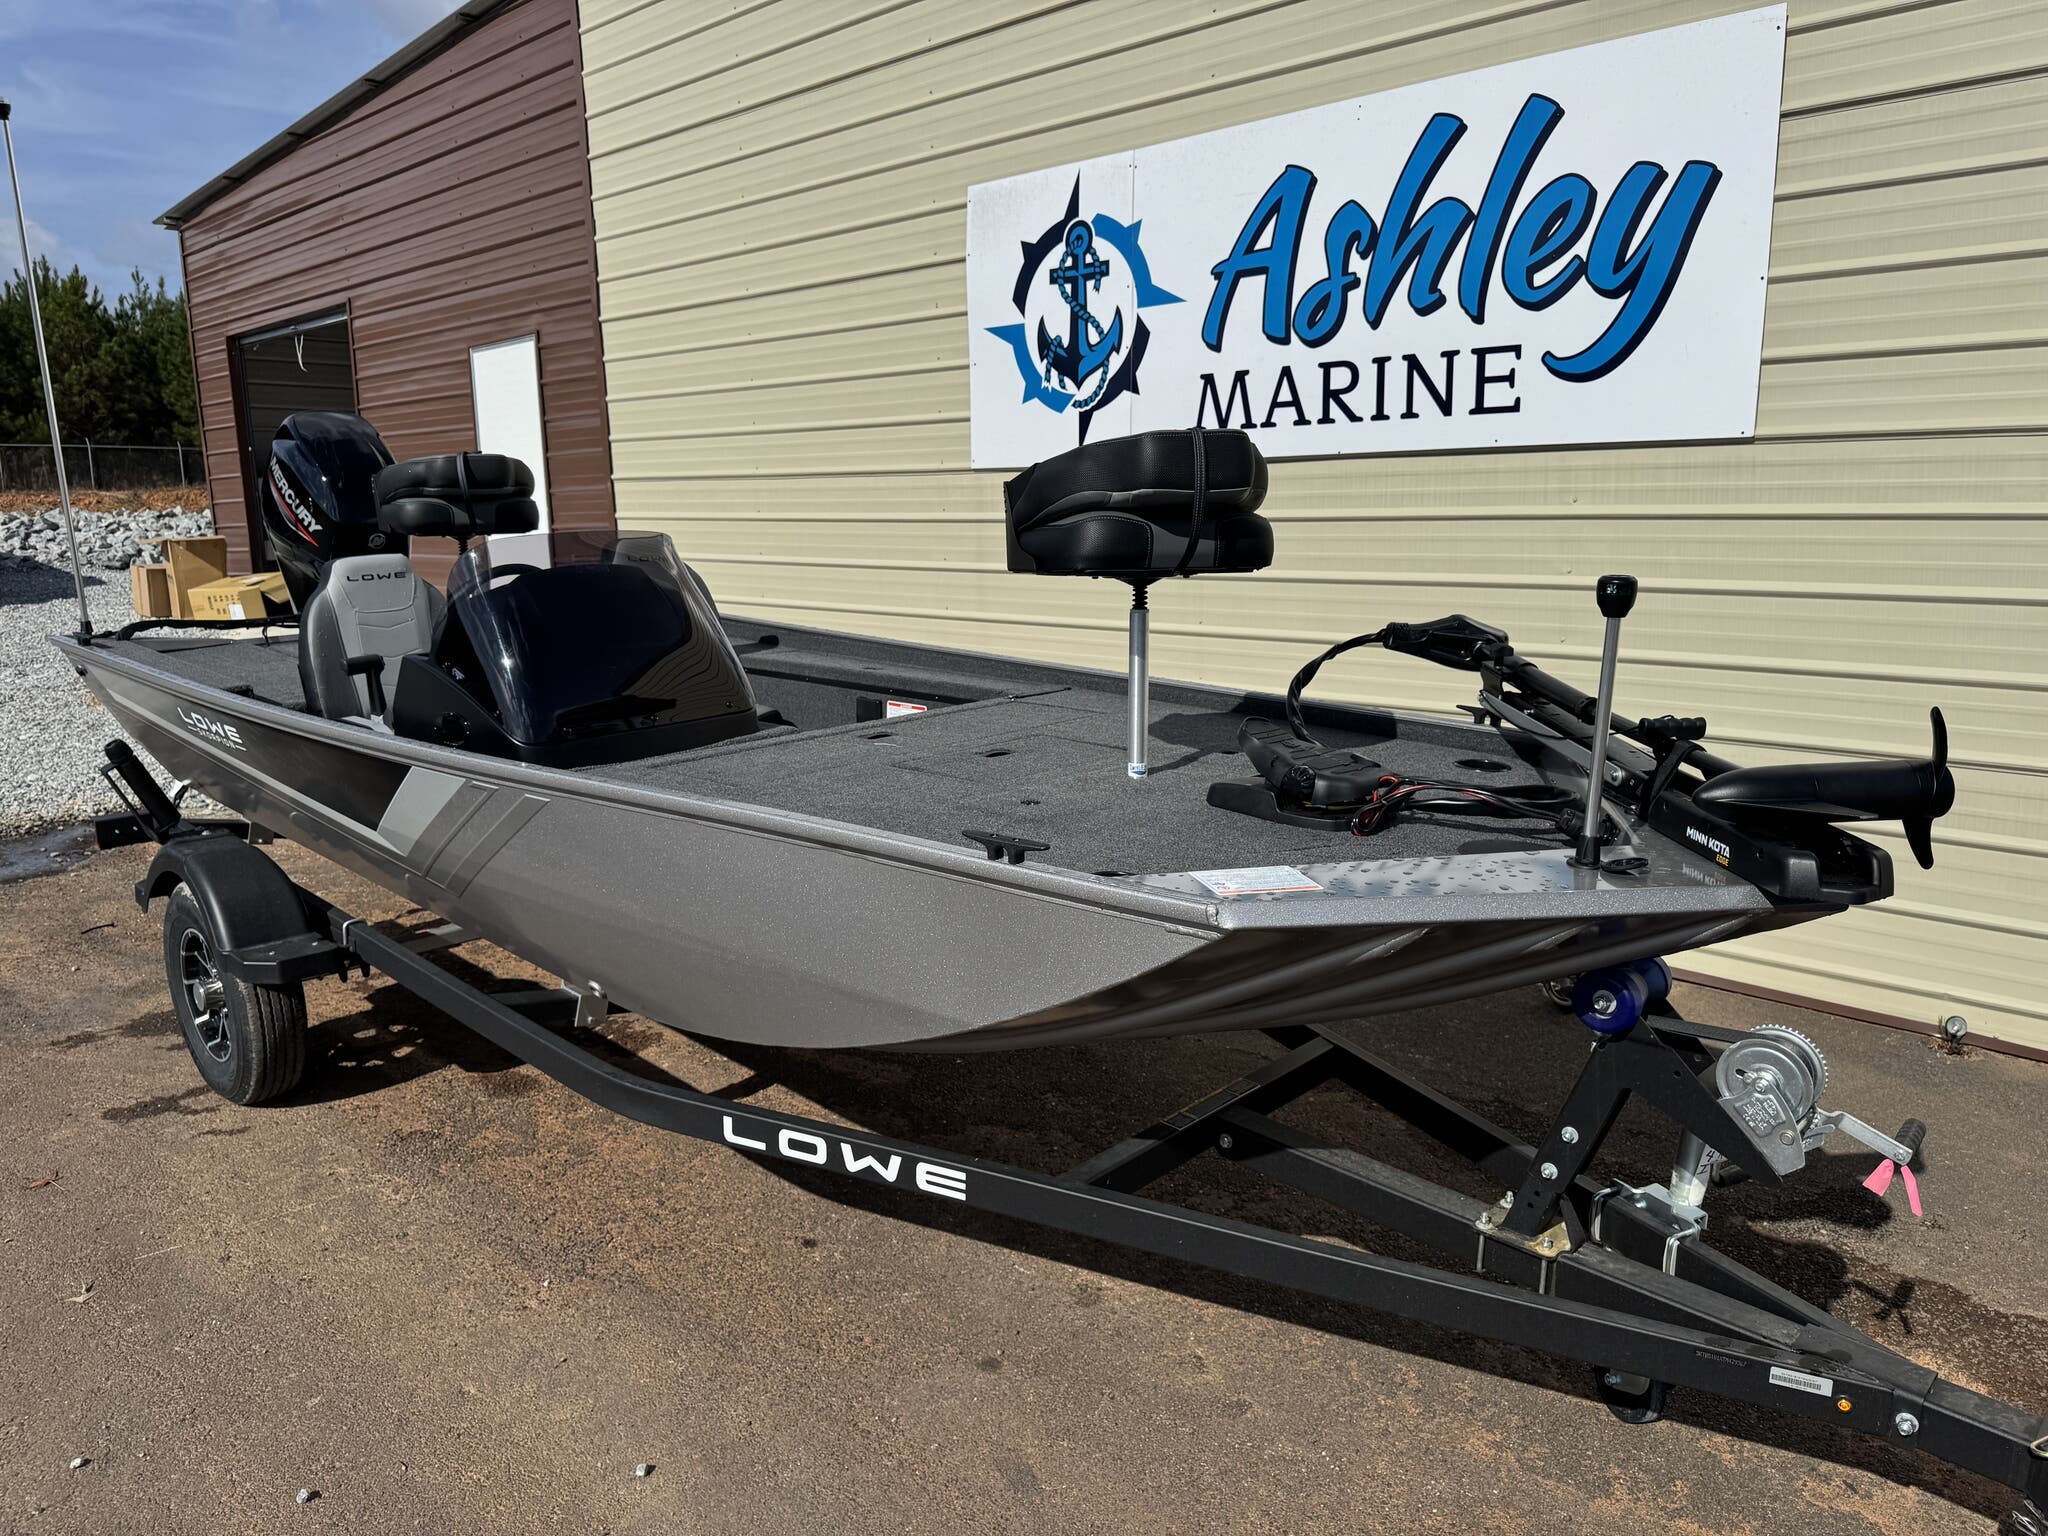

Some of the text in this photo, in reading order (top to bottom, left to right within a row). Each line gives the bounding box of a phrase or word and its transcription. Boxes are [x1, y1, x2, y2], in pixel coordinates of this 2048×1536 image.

[1201, 93, 1723, 384] Ashley
[1196, 344, 1522, 430] MARINE
[270, 455, 323, 532] MERCURY
[346, 571, 407, 582] LOWE
[177, 706, 243, 744] LOWE
[1686, 826, 1730, 858] MINN KOTA
[723, 1115, 967, 1201] LOWE
